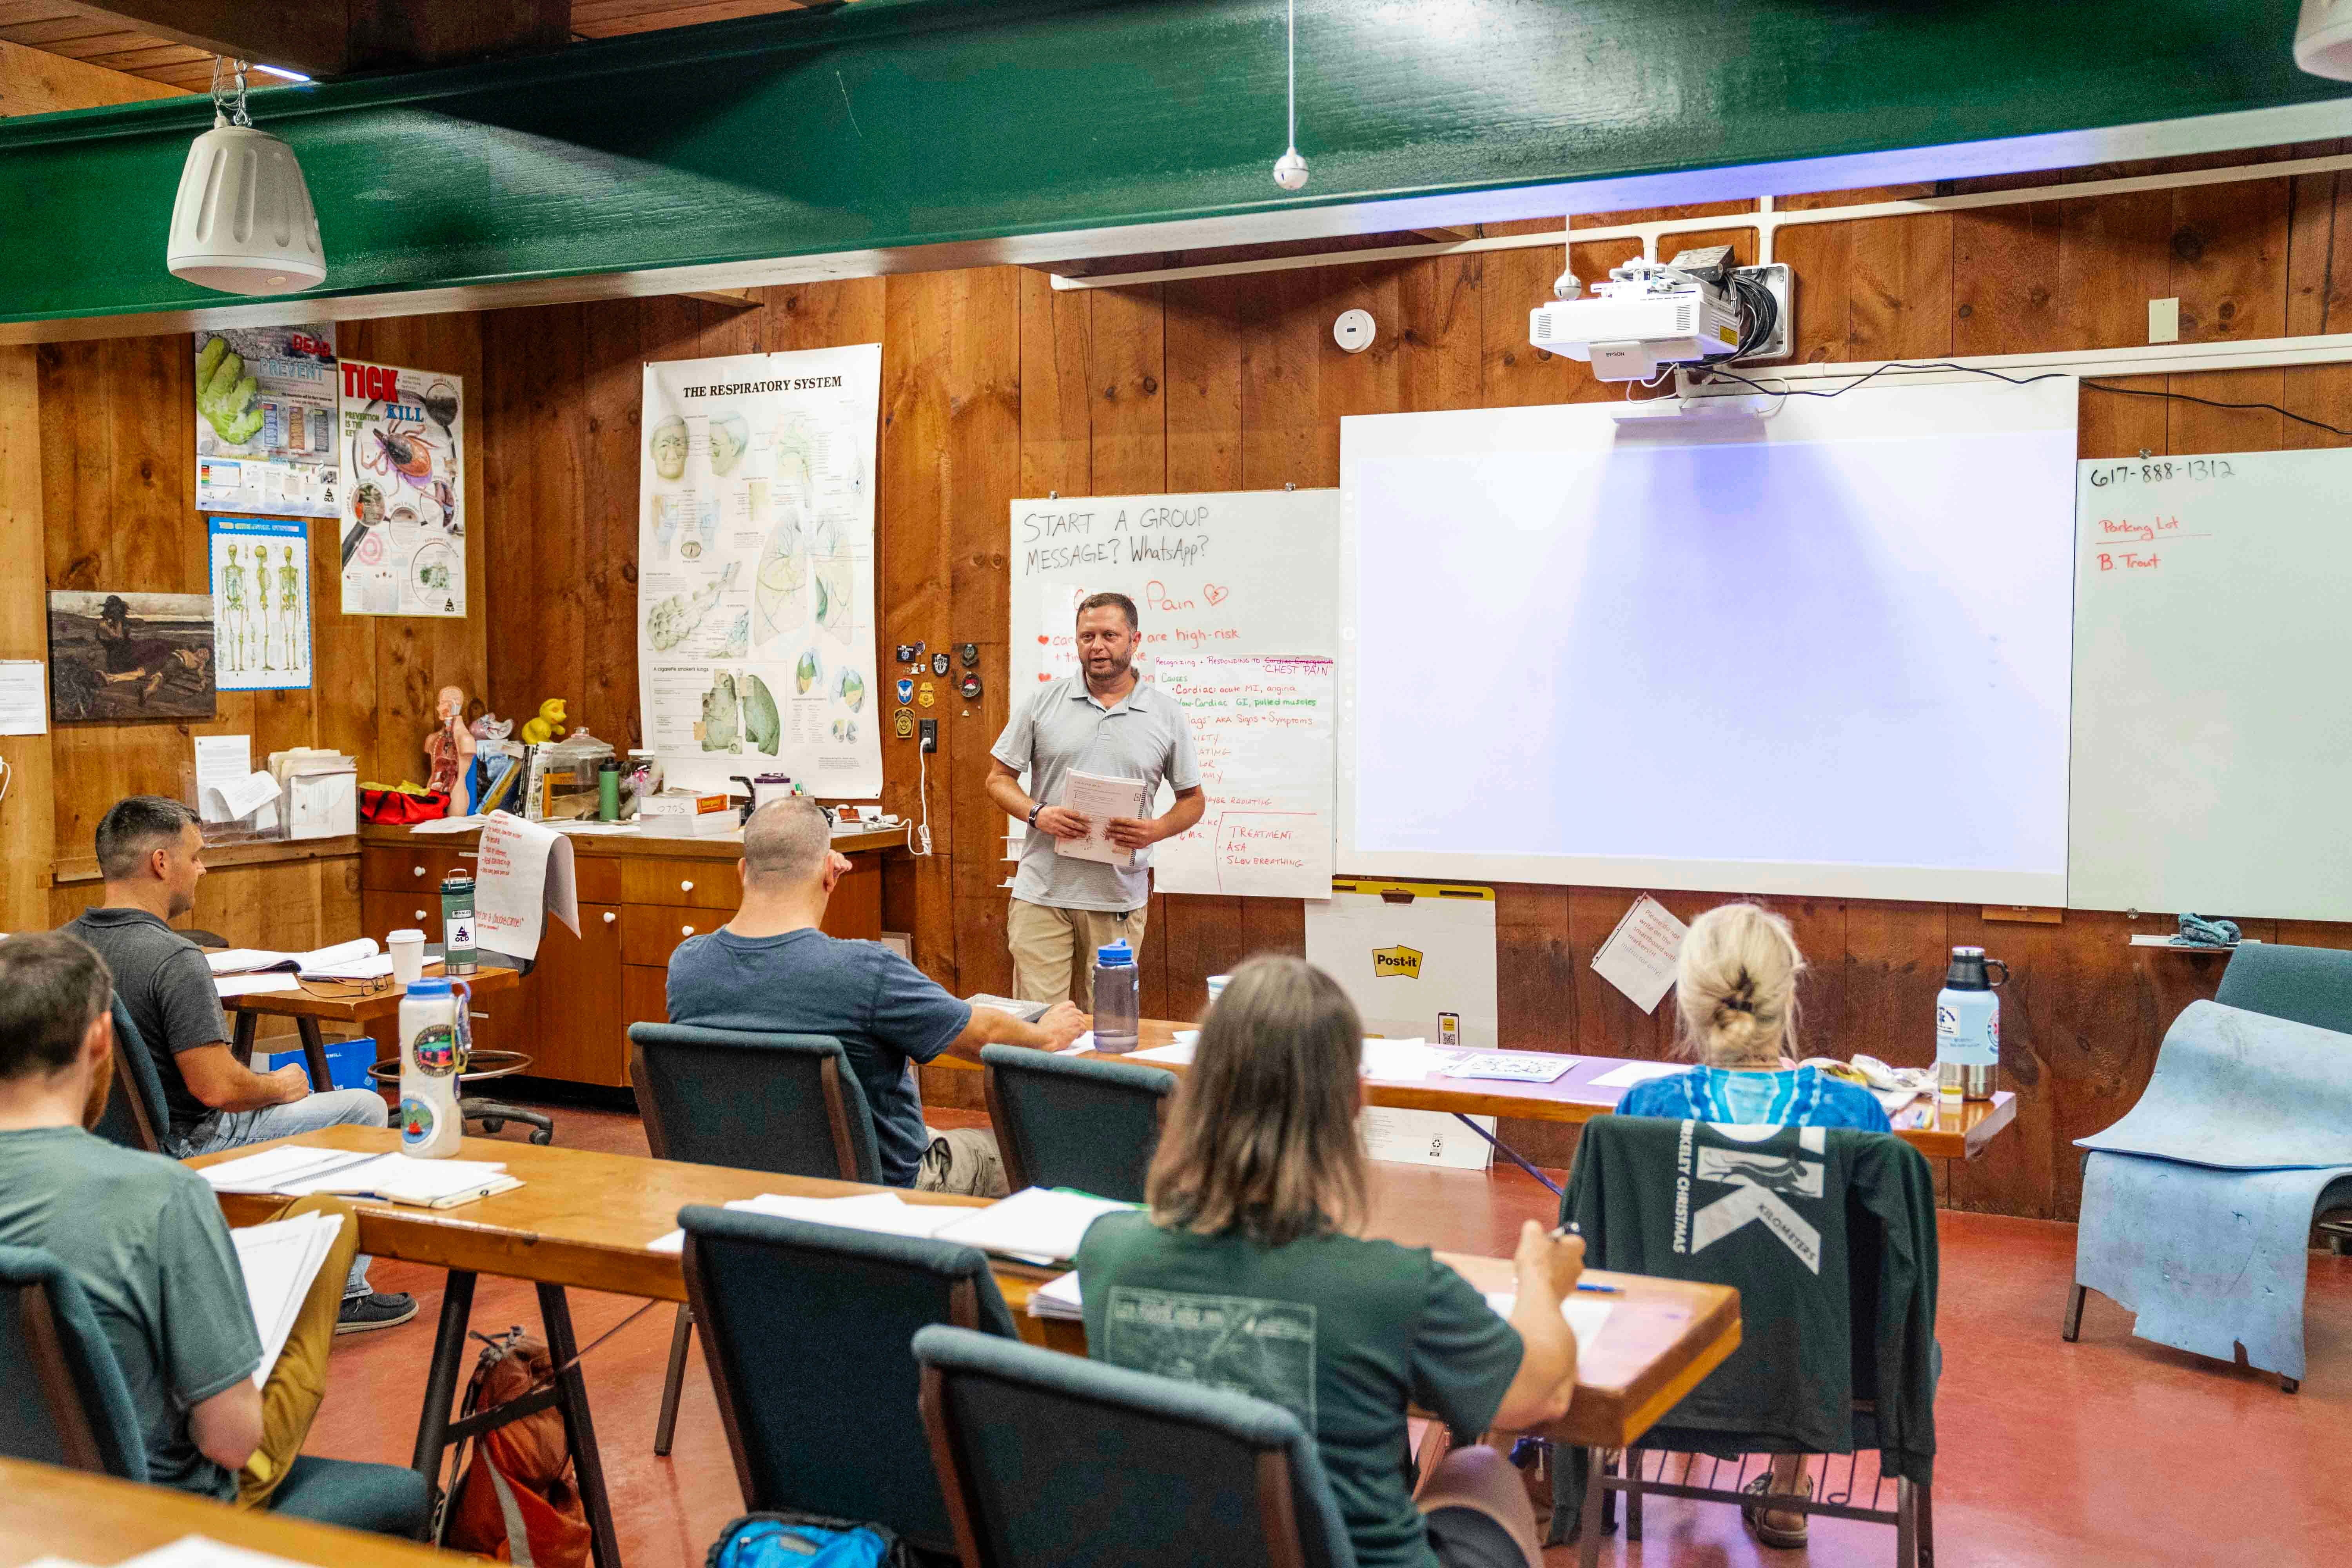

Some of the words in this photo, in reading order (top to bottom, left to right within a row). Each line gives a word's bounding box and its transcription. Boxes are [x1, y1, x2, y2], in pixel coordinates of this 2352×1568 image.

[683, 386, 706, 398] THE
[710, 379, 791, 396] RESPIRATORY
[794, 376, 842, 390] SYSTEM
[345, 411, 379, 422] PREVENTION
[386, 403, 424, 422] KILL
[352, 421, 363, 429] THE
[2091, 460, 2236, 486] 617-888-1312
[1024, 512, 1095, 543] START
[1114, 509, 1128, 532] A
[1140, 506, 1209, 529] GROUP
[2098, 520, 2154, 541] Parking
[2156, 516, 2179, 530] Lot
[1026, 539, 1119, 575] MESSAGE?
[1131, 534, 1210, 566] WhatsApp?
[2097, 553, 2117, 571] B.
[2119, 553, 2161, 570] Trout
[1146, 581, 1195, 611] Pain
[1147, 633, 1167, 643] are
[1176, 628, 1240, 649] high-risk
[1156, 657, 1195, 667] Recognizing
[1267, 685, 1296, 696] angina
[1254, 699, 1280, 707] pulled
[1283, 698, 1316, 706] muscles
[1236, 714, 1259, 724] Signs
[1269, 711, 1312, 728] Symptoms
[1230, 797, 1272, 806] RADIATING
[1229, 826, 1292, 839] TREATMENT
[1254, 857, 1304, 868] BREATHING
[1639, 918, 1653, 932] write
[1654, 929, 1662, 938] on
[1662, 934, 1671, 945] the
[1645, 909, 1663, 926] Please
[1670, 930, 1681, 940] not
[1633, 926, 1664, 953] smartboard
[1664, 949, 1677, 962] with
[1377, 954, 1417, 967] Post-it
